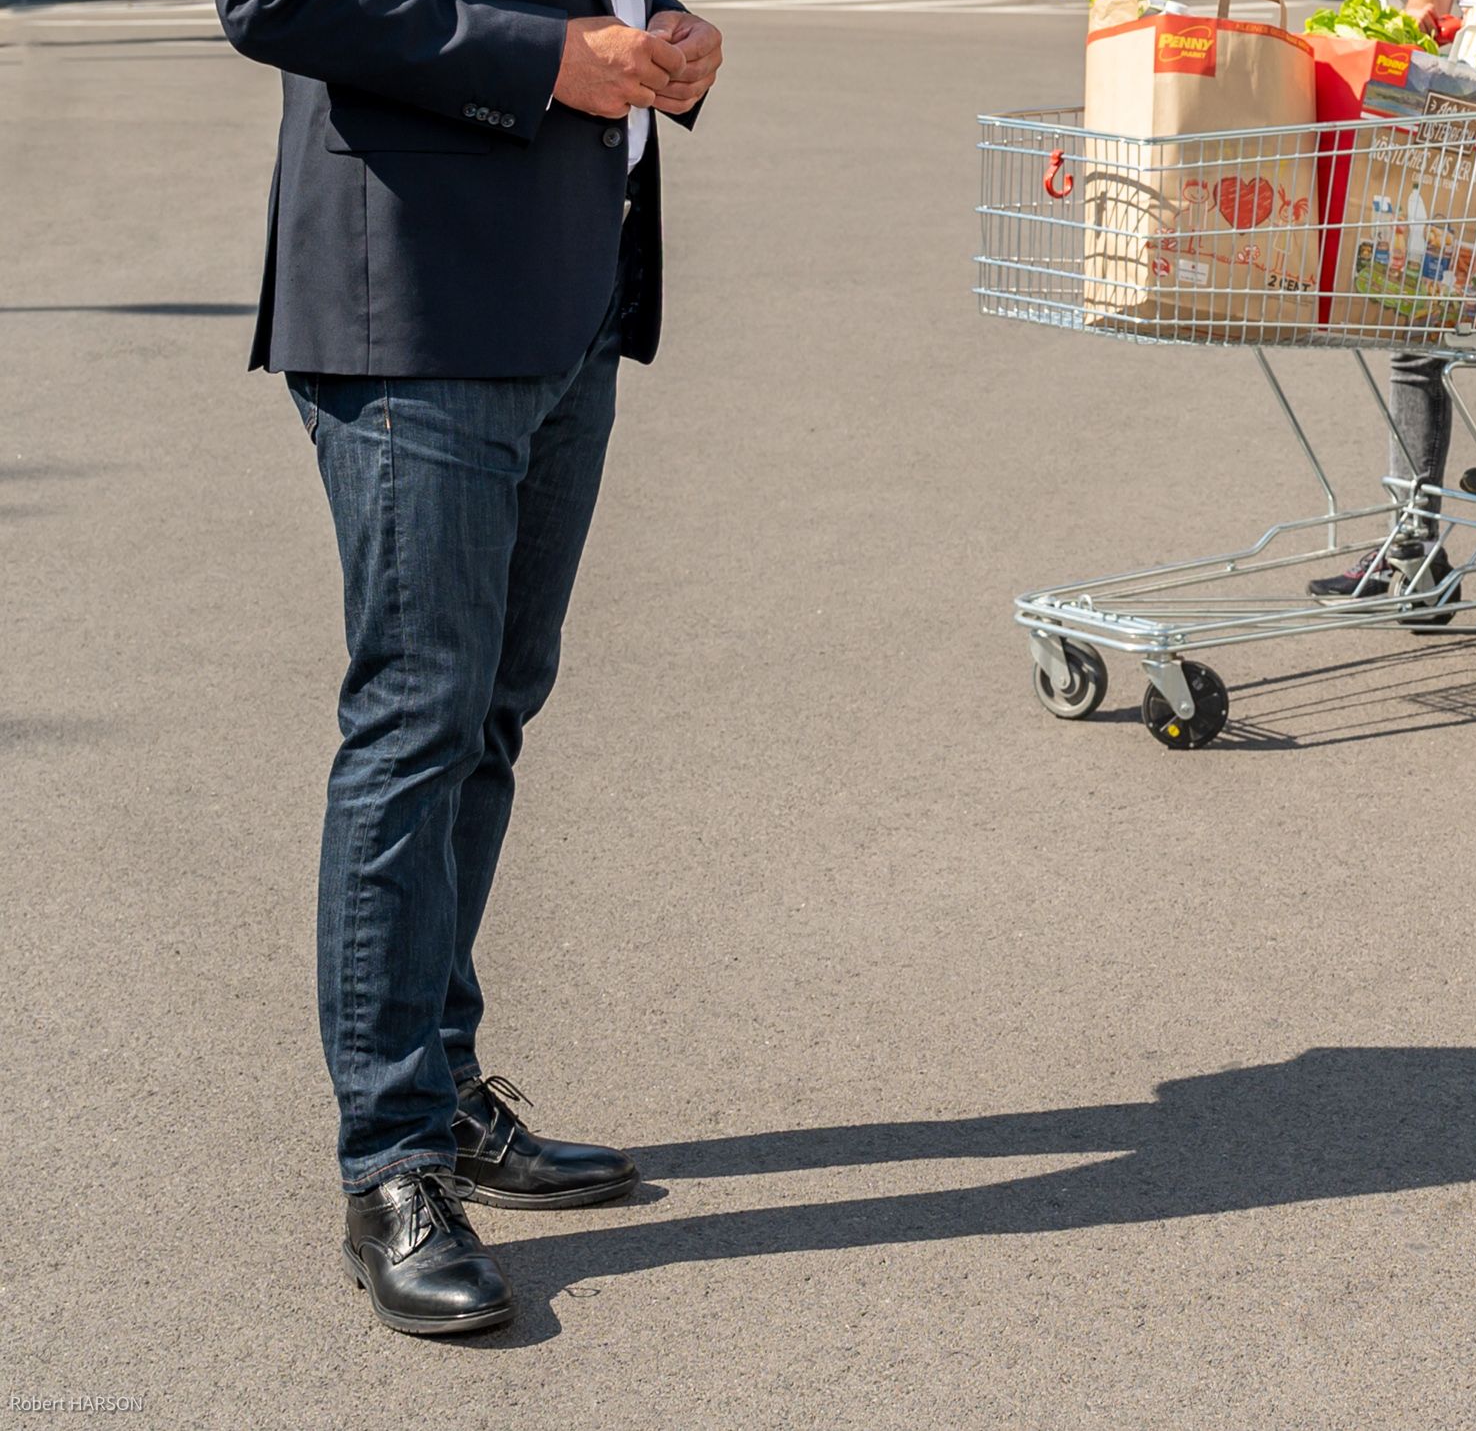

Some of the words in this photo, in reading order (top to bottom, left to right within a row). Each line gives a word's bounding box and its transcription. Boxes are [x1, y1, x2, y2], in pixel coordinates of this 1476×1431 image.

[1158, 33, 1215, 51] PENNY
[1376, 54, 1409, 71] PENNY
[1267, 274, 1278, 288] 2
